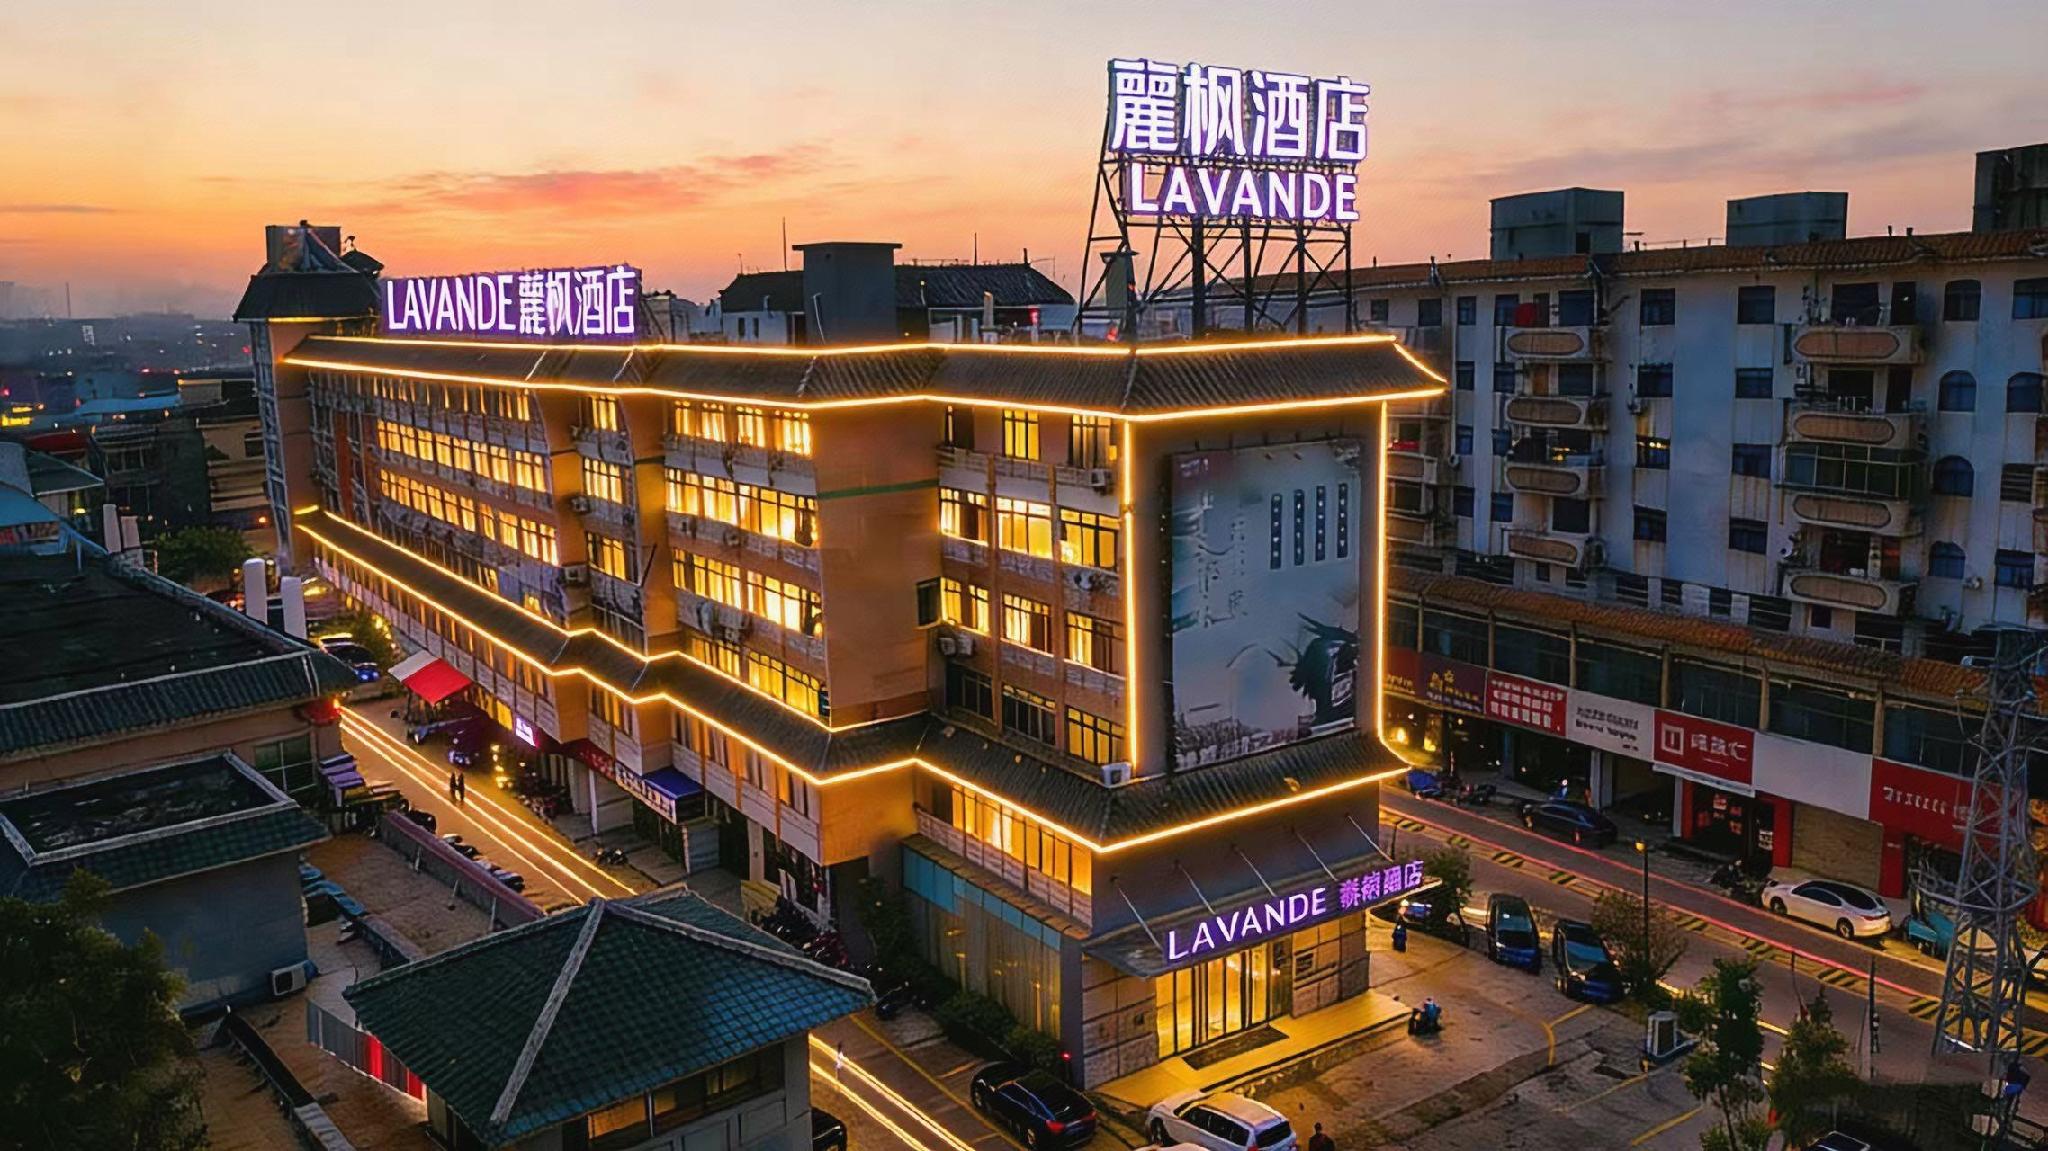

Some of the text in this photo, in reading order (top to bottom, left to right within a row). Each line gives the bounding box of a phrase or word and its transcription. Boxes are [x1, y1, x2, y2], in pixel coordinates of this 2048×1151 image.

[1130, 162, 1360, 221] LAVANDE
[386, 274, 516, 331] LAVANDE
[1169, 887, 1326, 960] LAVANDE
